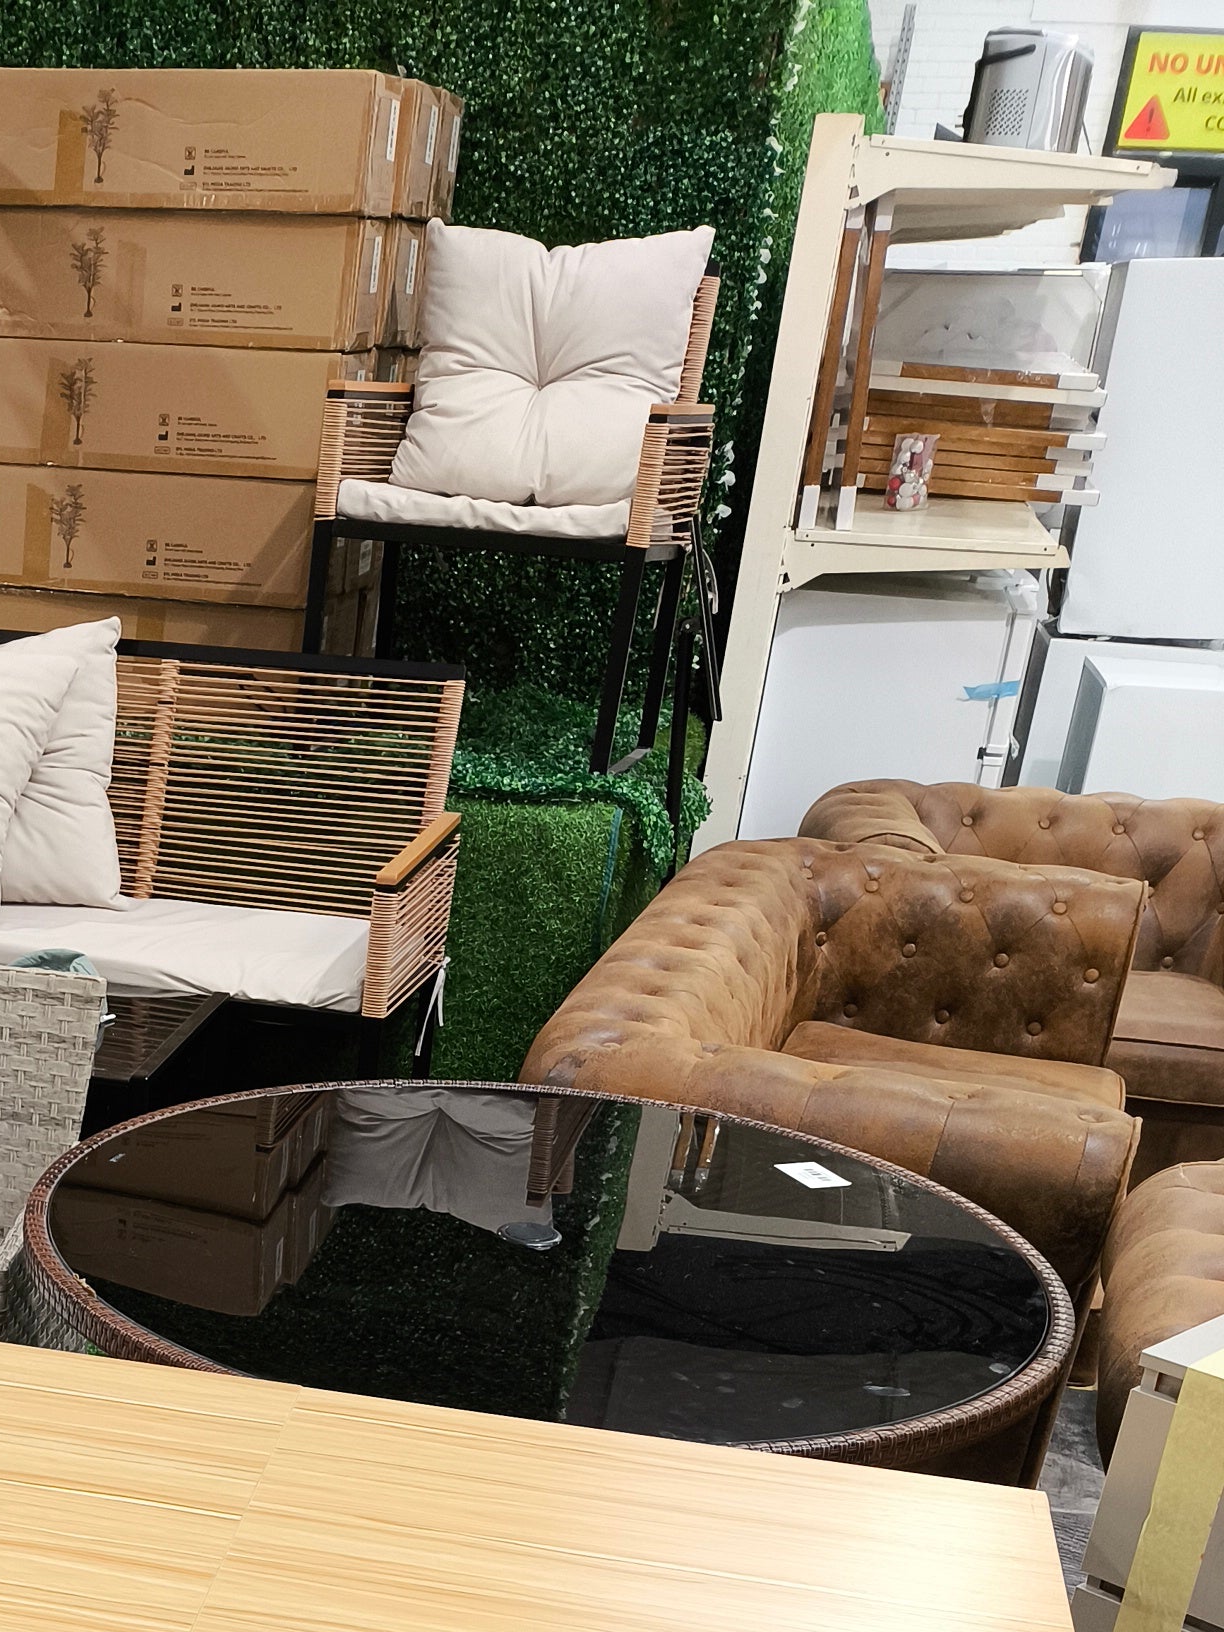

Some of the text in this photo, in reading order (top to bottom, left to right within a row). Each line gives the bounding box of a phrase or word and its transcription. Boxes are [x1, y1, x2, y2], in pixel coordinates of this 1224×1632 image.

[1148, 52, 1189, 75] NO
[1173, 86, 1224, 104] All ex
